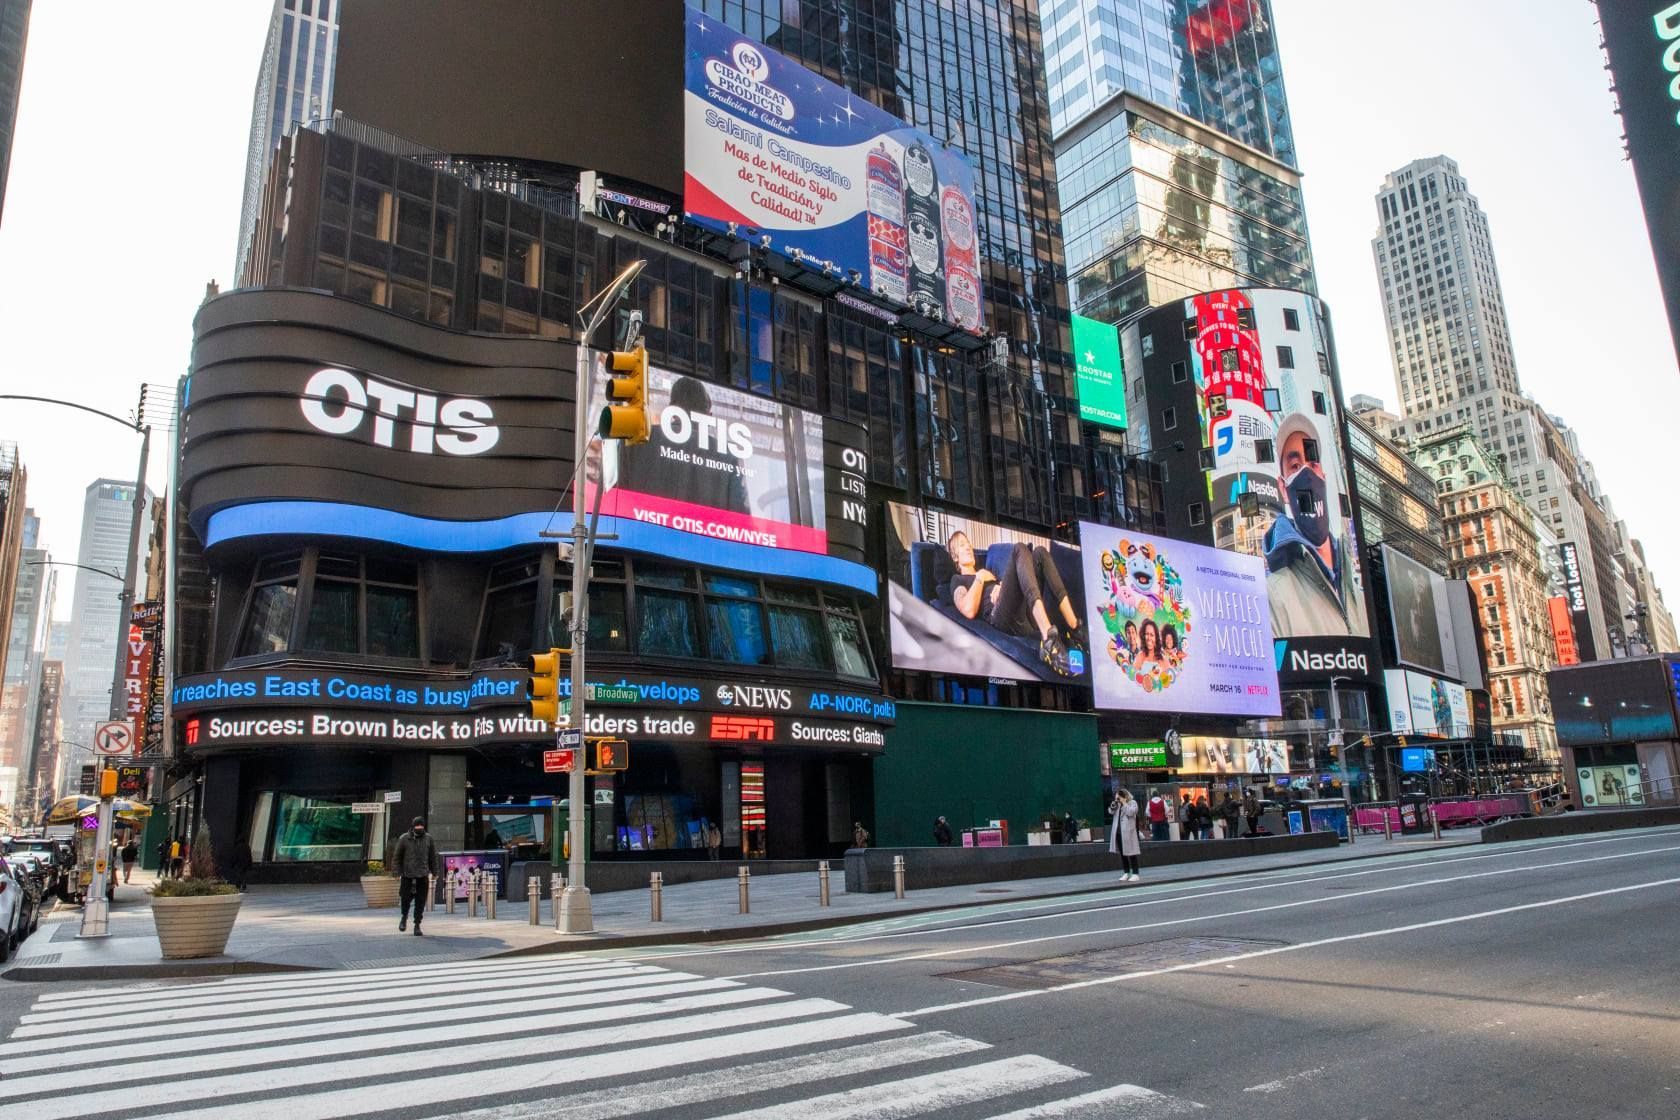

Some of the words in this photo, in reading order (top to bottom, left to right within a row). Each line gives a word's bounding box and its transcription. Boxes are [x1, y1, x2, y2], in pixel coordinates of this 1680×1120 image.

[713, 62, 751, 88] CIBAO
[755, 82, 787, 106] MEAT
[719, 76, 784, 116] PRODUCTS
[748, 108, 759, 119] de
[705, 109, 763, 150] Salami
[767, 138, 851, 190] Campesino
[724, 140, 750, 163] Mas
[752, 154, 769, 171] de
[770, 161, 806, 188] Medio
[808, 179, 838, 203] Siglo
[738, 167, 755, 184] de
[756, 173, 815, 210] Tradición
[815, 202, 823, 216] y
[751, 191, 803, 223] Calidad!
[300, 368, 500, 456] OTIS
[660, 405, 753, 460] OTIS
[660, 445, 690, 462] Made
[692, 455, 703, 466] to
[705, 459, 734, 473] move
[1247, 480, 1279, 502] Nasdaq
[633, 506, 669, 527] VISIT
[672, 514, 777, 548] OTIS.COM/NYSE
[1564, 545, 1580, 584] Locker
[1196, 586, 1261, 626] WAFFLES
[1571, 585, 1586, 611] Foot
[1215, 622, 1266, 658] MOCHI
[1291, 647, 1368, 675] Nasdaq
[181, 679, 257, 702] reaches
[264, 676, 321, 697] East
[327, 677, 392, 702] Coast
[396, 686, 418, 705] as
[424, 686, 471, 708] busy
[597, 687, 638, 703] Broadway
[734, 686, 792, 710] NEWS
[809, 692, 872, 715] AP-NORC
[1210, 683, 1233, 693] MARCH
[1234, 685, 1242, 694] 16
[1247, 685, 1269, 696] NETFLIX
[209, 718, 305, 738] Sources:
[312, 714, 387, 738] Brown
[392, 719, 446, 740] back
[450, 721, 471, 740] to
[554, 713, 638, 734] Riders
[642, 715, 696, 736] trade
[711, 716, 774, 741] ESPN
[791, 722, 850, 742] Sources:
[852, 725, 882, 746] Giants
[1112, 747, 1165, 756] STARBUCKS
[1121, 755, 1154, 764] COFFEE
[123, 768, 141, 776] Deli
